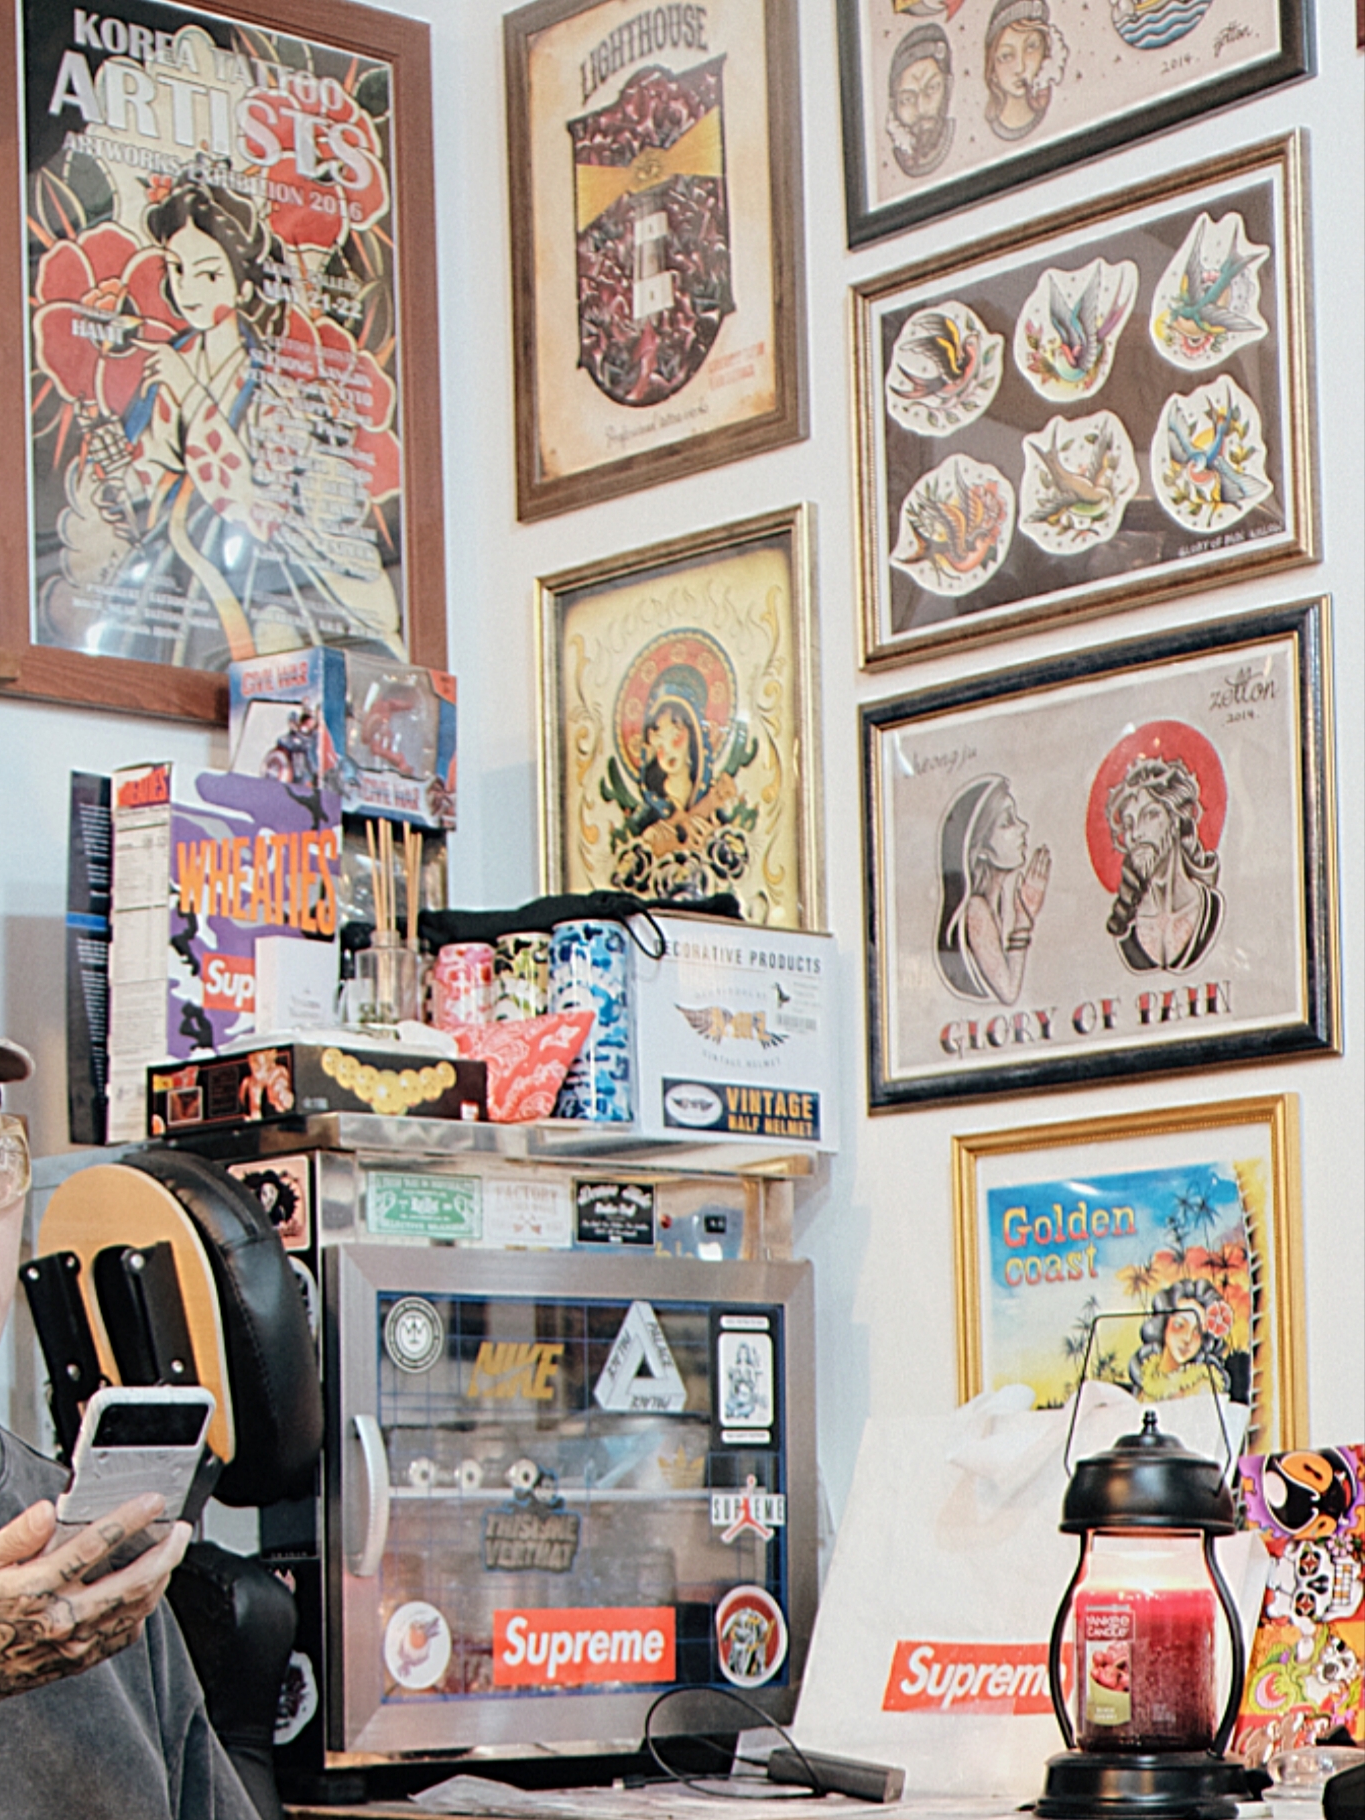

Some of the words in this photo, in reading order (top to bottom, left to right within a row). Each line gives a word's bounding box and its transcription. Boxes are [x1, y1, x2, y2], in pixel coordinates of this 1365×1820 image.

[73, 9, 198, 74] KOREA
[580, 4, 709, 107] LIGHTHOUSE
[48, 50, 373, 190] ARTISTS
[63, 131, 182, 176] ARTWORKS
[176, 829, 339, 936] WHEATIES
[750, 951, 822, 975] PRODUCTS
[940, 1005, 1057, 1060] GLORY
[1072, 998, 1121, 1036] OF
[1137, 979, 1232, 1026] PAIN
[725, 1086, 813, 1119] VINTAGE
[728, 1114, 760, 1133] HALF
[764, 1117, 814, 1138] HELMET
[1002, 1202, 1135, 1248] Golden
[1004, 1243, 1098, 1287] coast
[646, 1321, 675, 1369] PALACE
[467, 1341, 565, 1399] NIKE
[714, 1499, 784, 1521] SUPEME
[1087, 1615, 1130, 1628] YANKEE
[1087, 1624, 1130, 1638] CANDLE
[502, 1617, 665, 1677] Supreme
